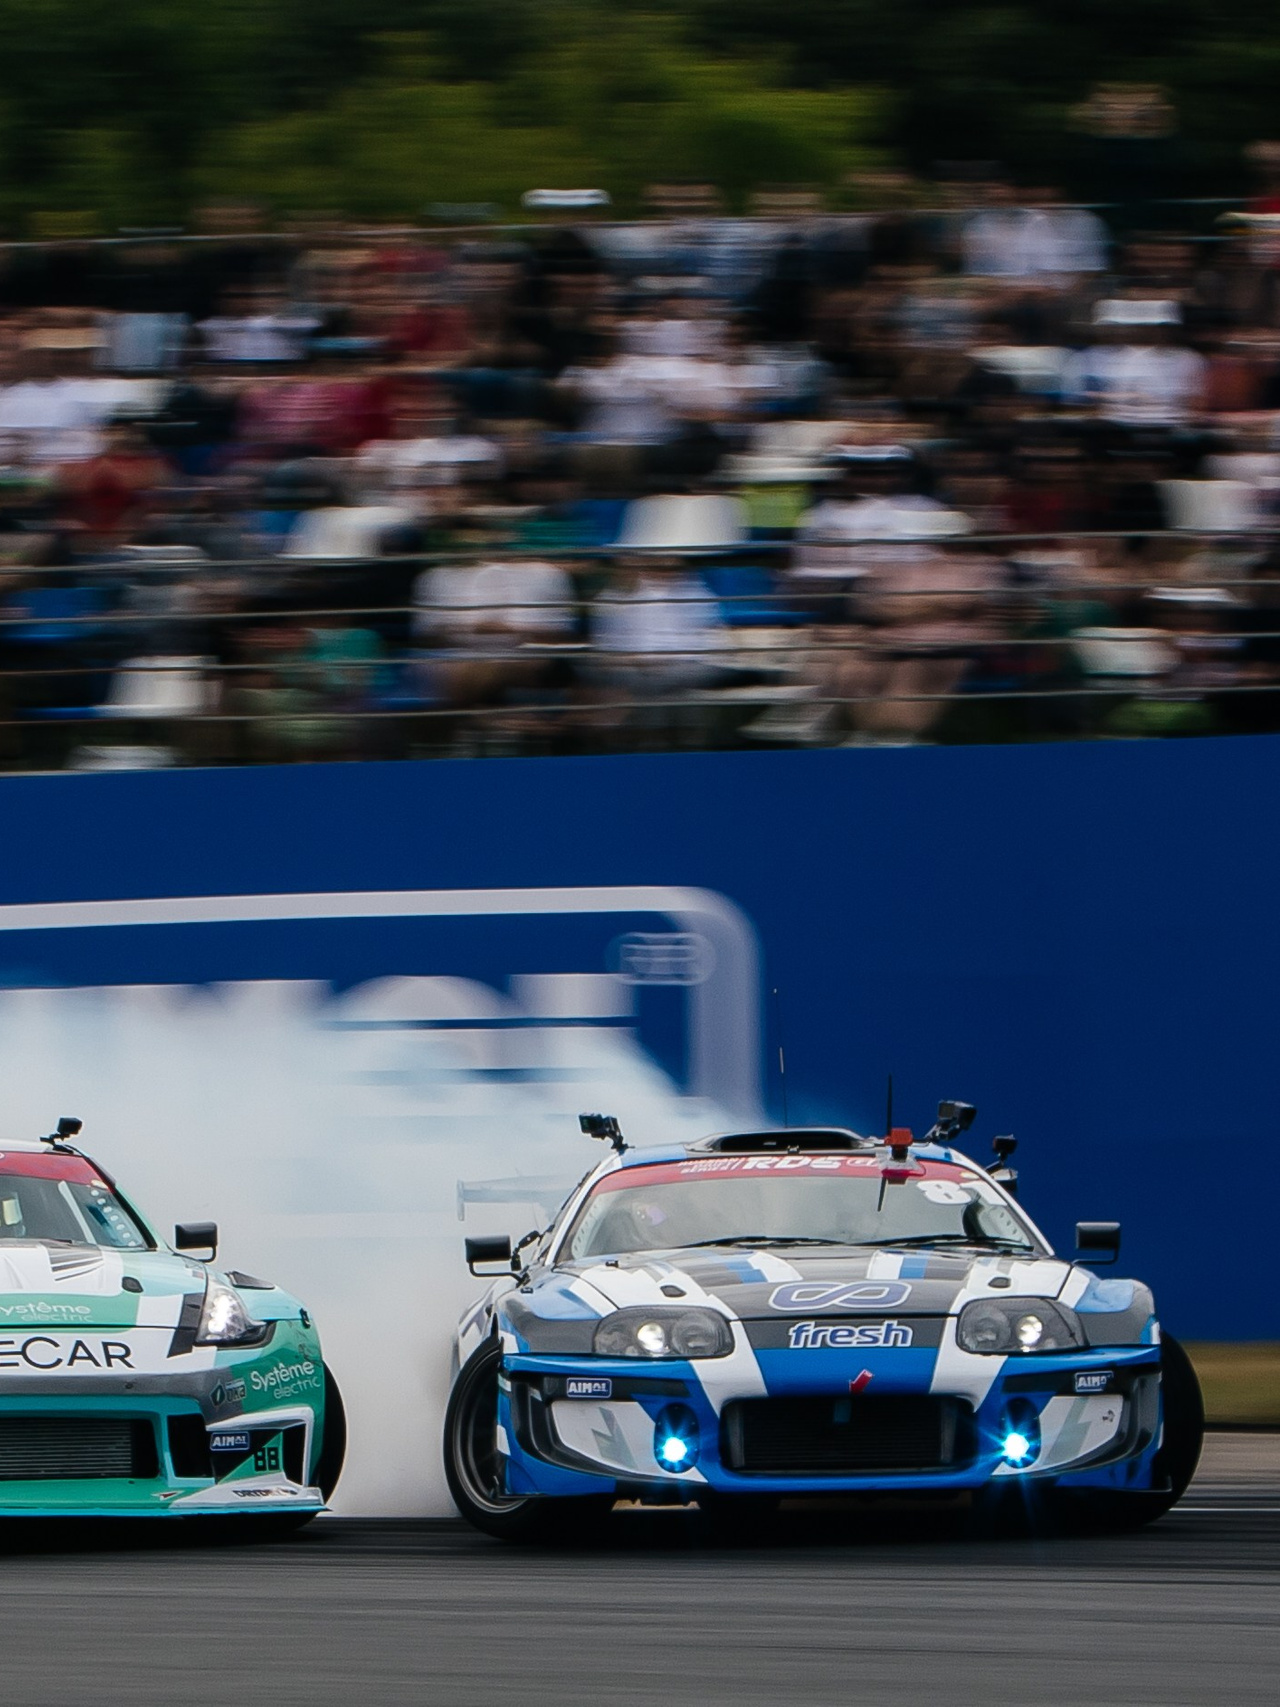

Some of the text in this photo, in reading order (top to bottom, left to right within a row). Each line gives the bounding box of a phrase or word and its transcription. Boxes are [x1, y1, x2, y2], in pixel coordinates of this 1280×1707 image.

[742, 1155, 842, 1170] RDS
[788, 1319, 914, 1349] fresh
[250, 1360, 315, 1392] Système
[273, 1376, 321, 1400] electric
[254, 1446, 281, 1472] 88
